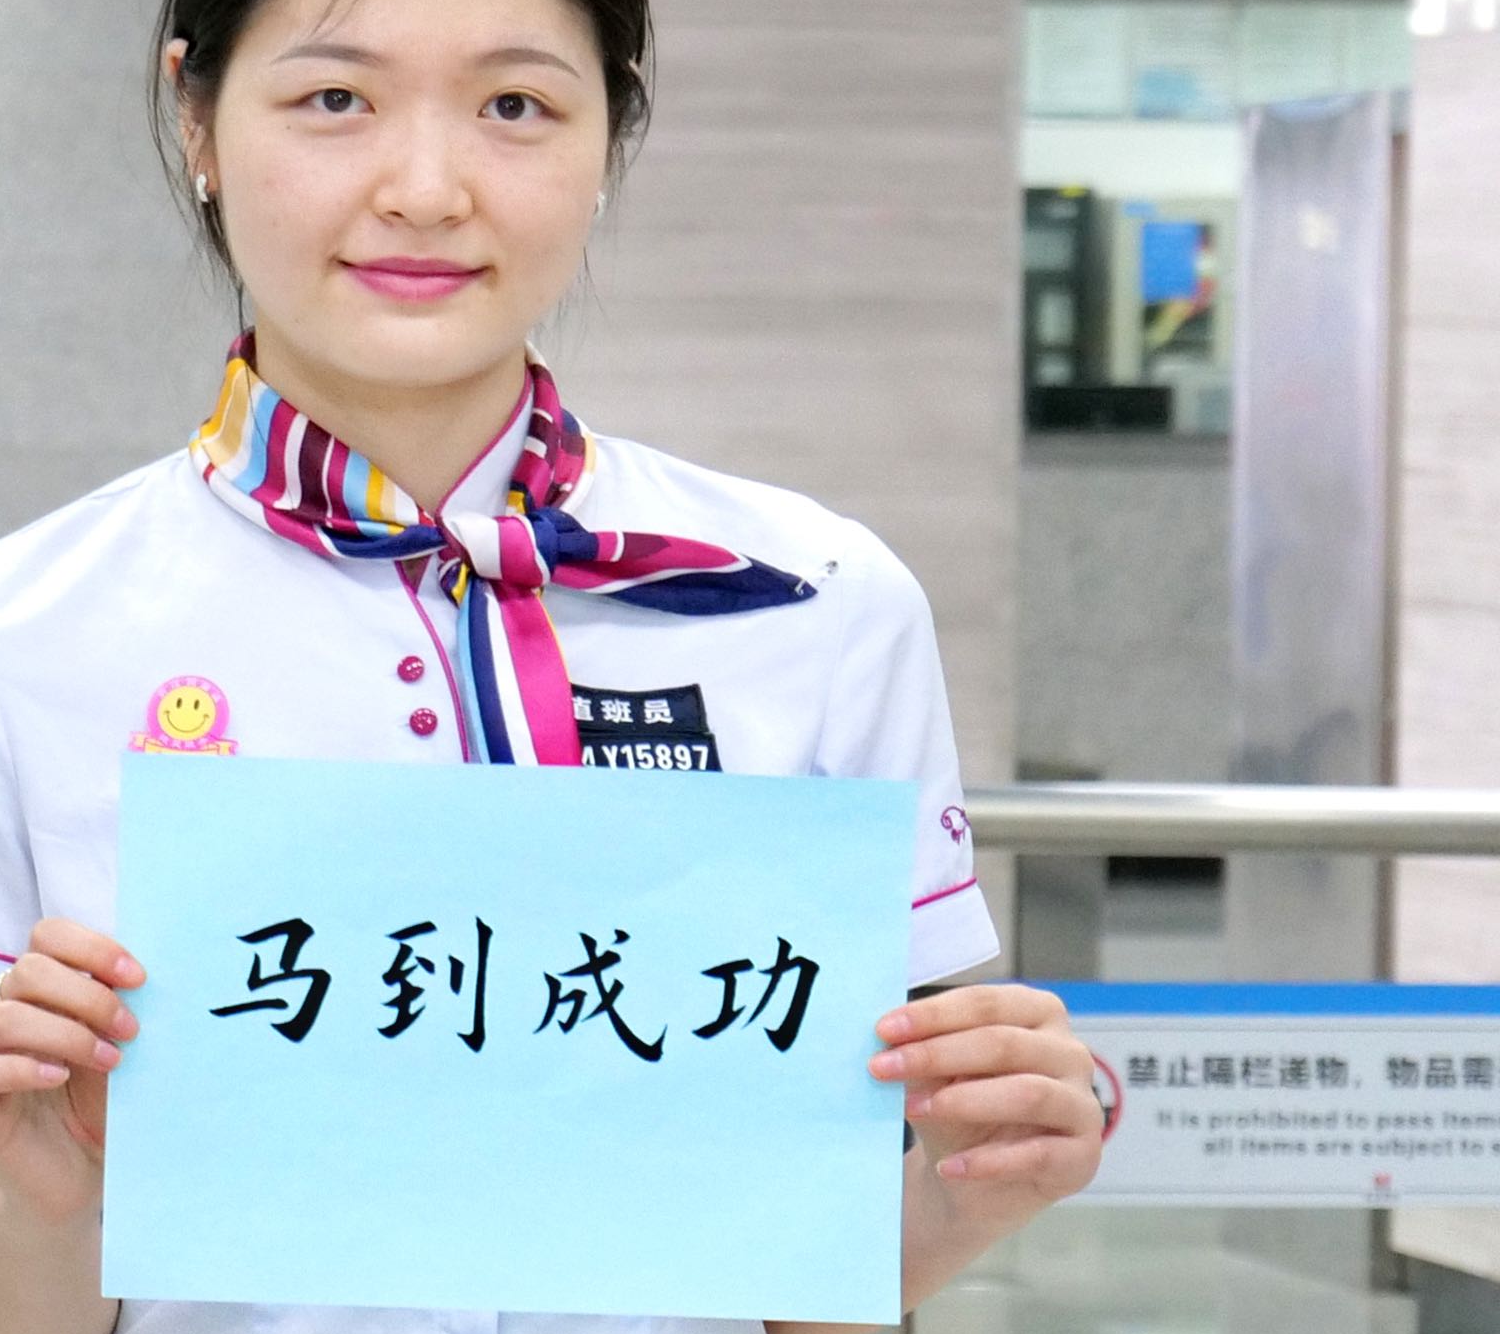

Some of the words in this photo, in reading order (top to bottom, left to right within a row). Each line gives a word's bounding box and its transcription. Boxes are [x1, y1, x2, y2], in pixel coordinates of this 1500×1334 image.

[209, 916, 821, 1063] 马到成功
[1209, 1110, 1338, 1130] prohibited
[1443, 1111, 1500, 1128] item
[1241, 1139, 1307, 1155] items
[1315, 1142, 1352, 1155] are
[1361, 1139, 1453, 1160] subject
